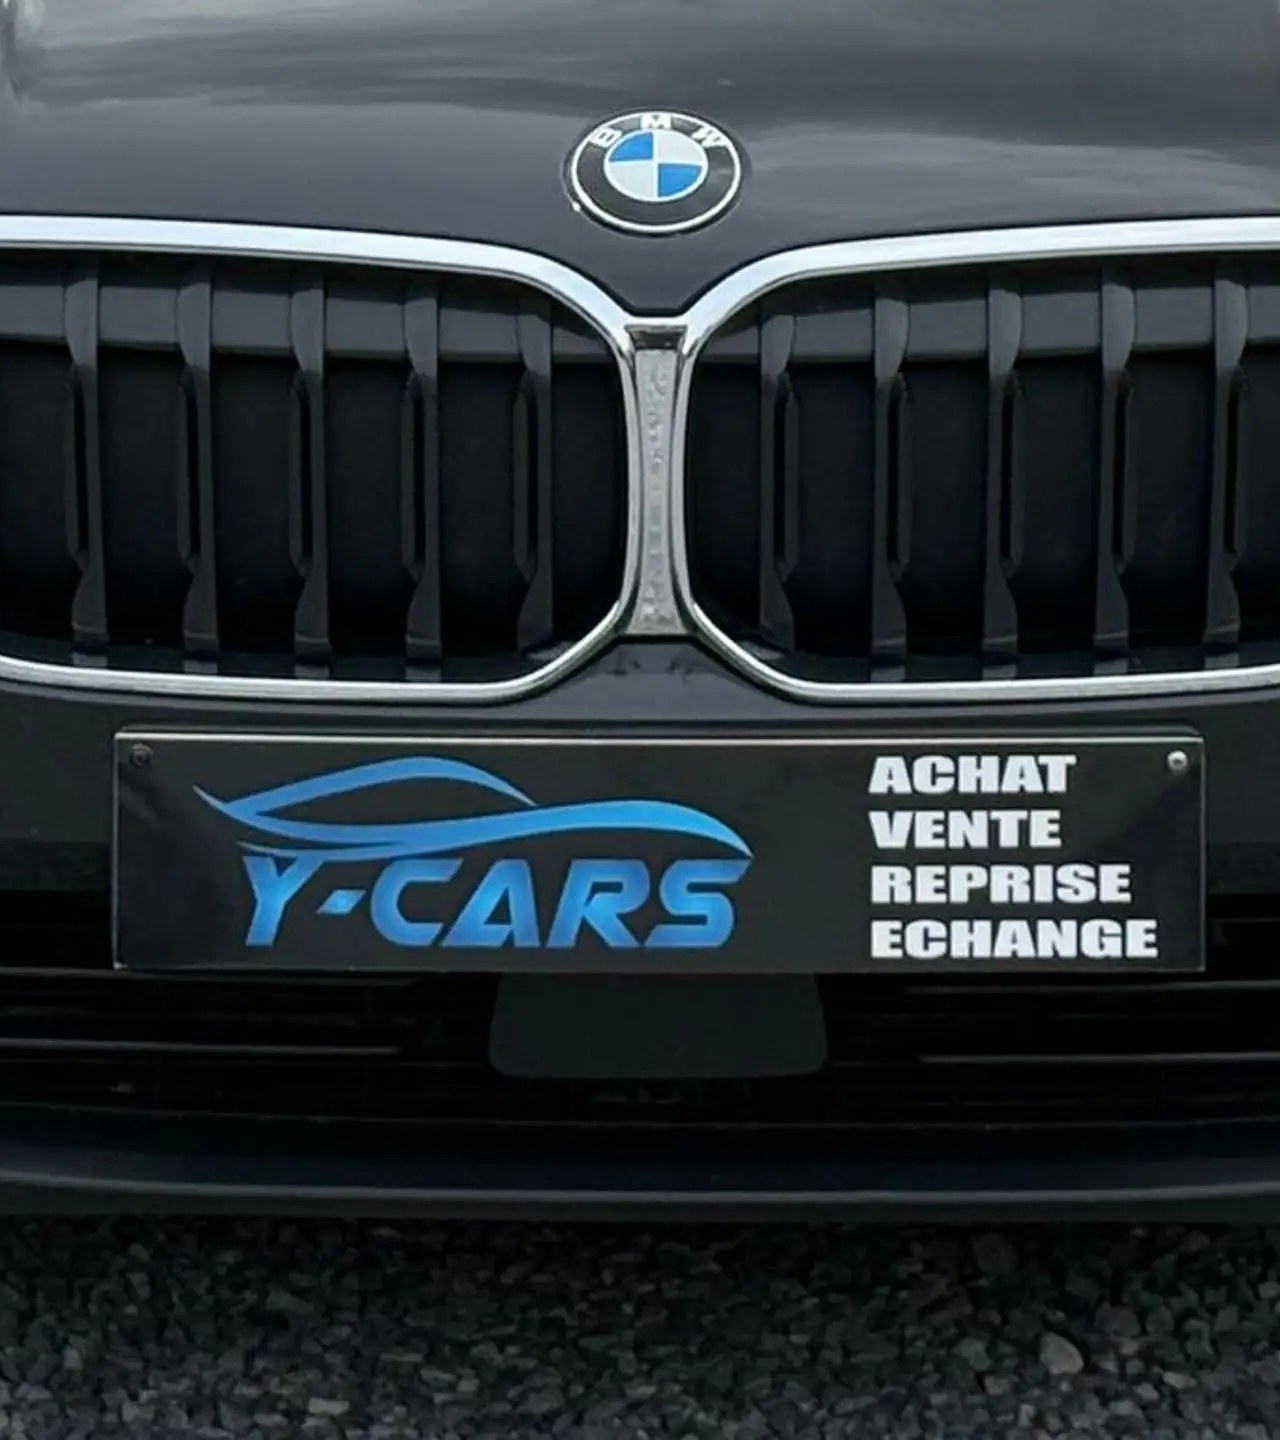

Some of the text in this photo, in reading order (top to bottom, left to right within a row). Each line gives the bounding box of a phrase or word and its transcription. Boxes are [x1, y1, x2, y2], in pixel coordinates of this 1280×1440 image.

[588, 113, 726, 149] BMW
[867, 755, 1077, 795] ACHAT
[867, 809, 1063, 849] VENTE
[241, 855, 753, 948] Y-CARS
[869, 863, 1133, 905] REPRISE
[870, 917, 1160, 960] ECHANGE
